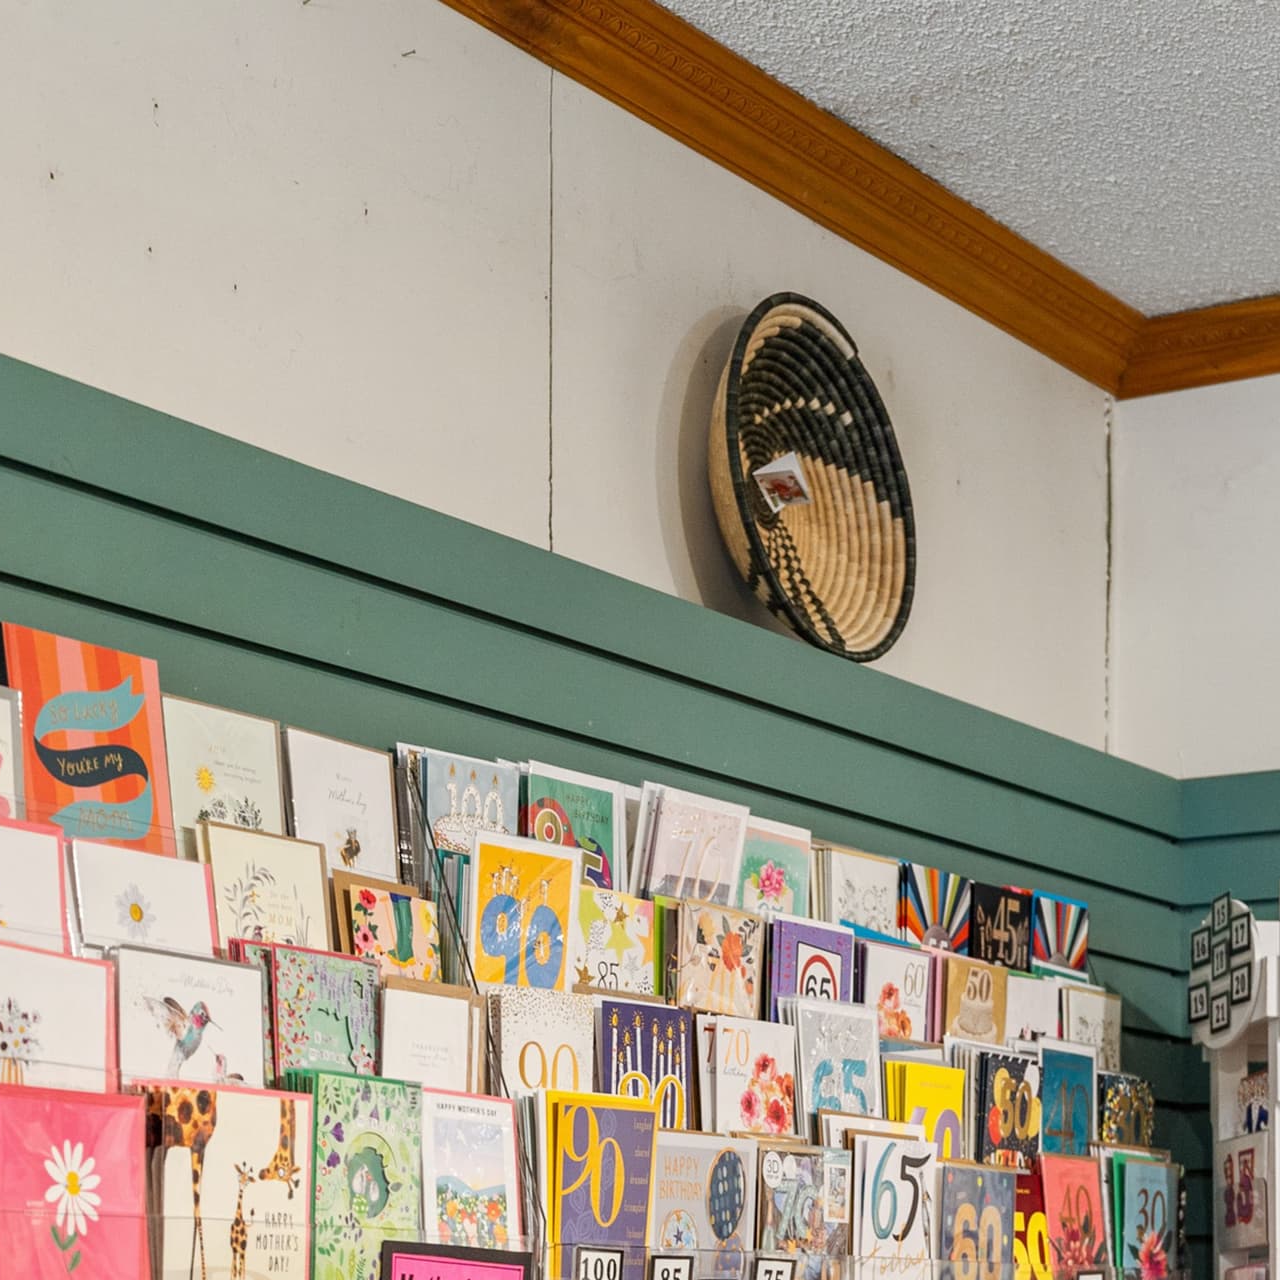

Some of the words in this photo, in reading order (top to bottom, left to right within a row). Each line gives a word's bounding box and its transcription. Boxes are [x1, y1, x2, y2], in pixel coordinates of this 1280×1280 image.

[446, 783, 504, 831] 100
[993, 896, 1020, 970] 45
[1235, 924, 1245, 941] 17
[1196, 939, 1207, 956] 16
[598, 961, 619, 989] 85
[904, 962, 924, 998] 60
[1235, 973, 1245, 992] 20
[966, 969, 993, 1001] 50
[1193, 995, 1204, 1014] 19
[1216, 1005, 1226, 1023] 21
[723, 1028, 750, 1067] 70
[562, 1105, 625, 1228] 90
[664, 1156, 699, 1176] HAPPY
[659, 1181, 701, 1200] BIRTHDAY
[872, 1141, 932, 1241] 65
[264, 1212, 294, 1230] HAPPY
[255, 1234, 299, 1252] MOTHER'S
[268, 1255, 290, 1272] DAY!
